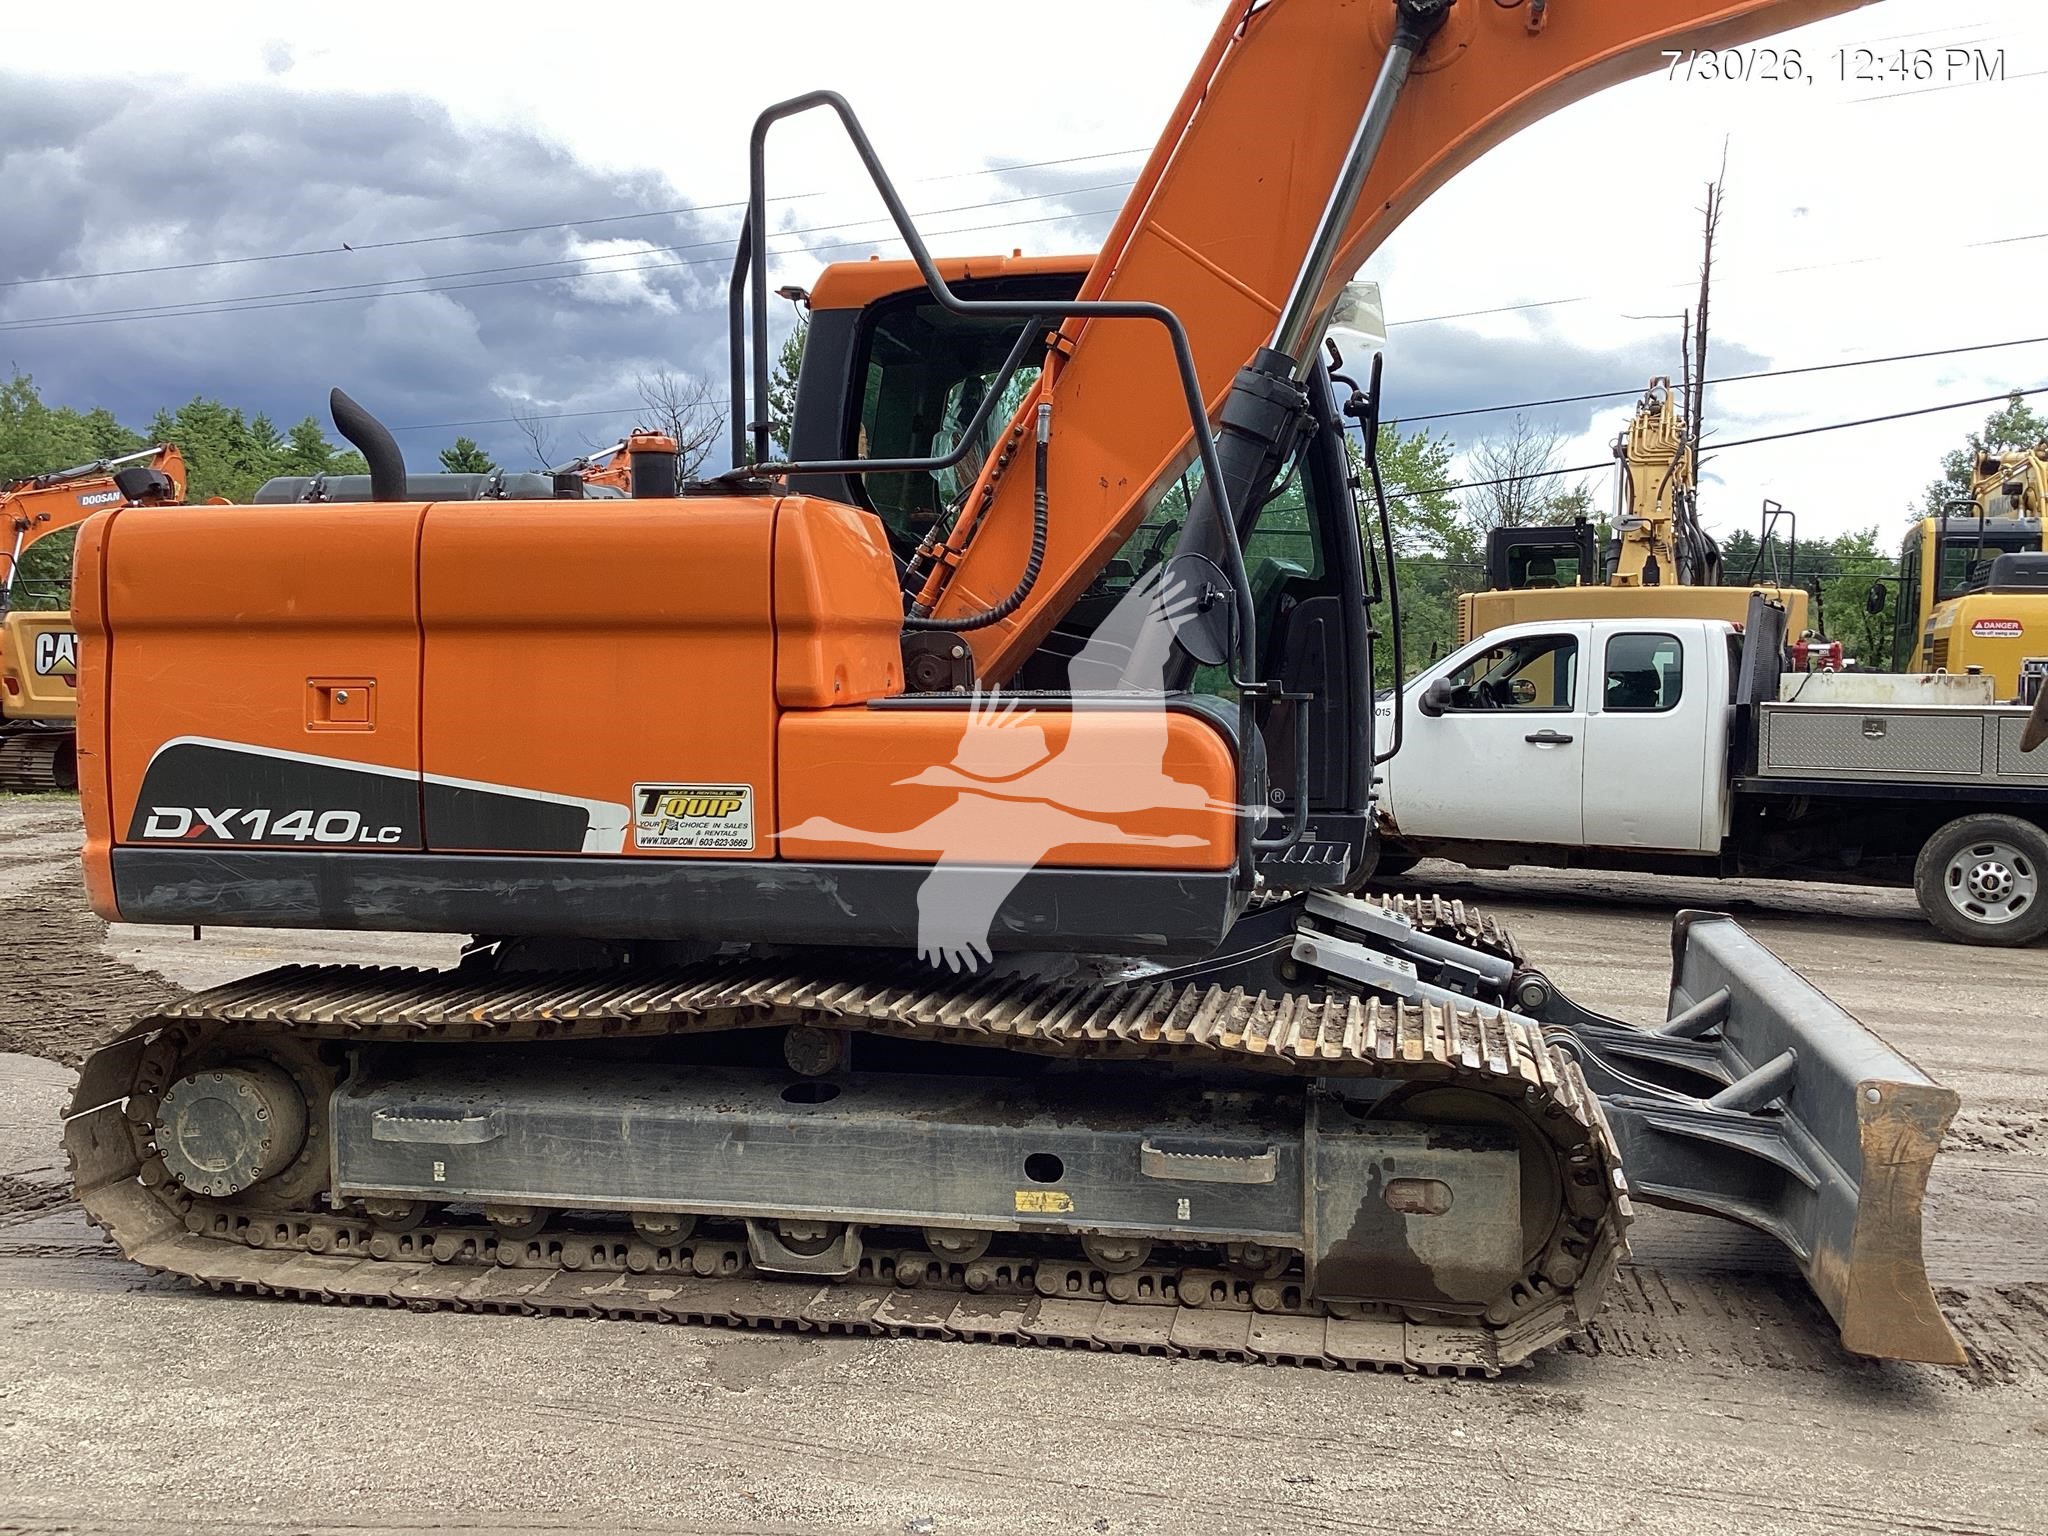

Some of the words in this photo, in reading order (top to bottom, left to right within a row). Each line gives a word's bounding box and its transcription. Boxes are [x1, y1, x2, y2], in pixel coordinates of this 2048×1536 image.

[82, 491, 121, 506] DOOSAN
[36, 633, 78, 674] CA
[639, 789, 747, 819] T-QUIP
[723, 822, 748, 830] SALES
[698, 839, 748, 847] 603-623-3669
